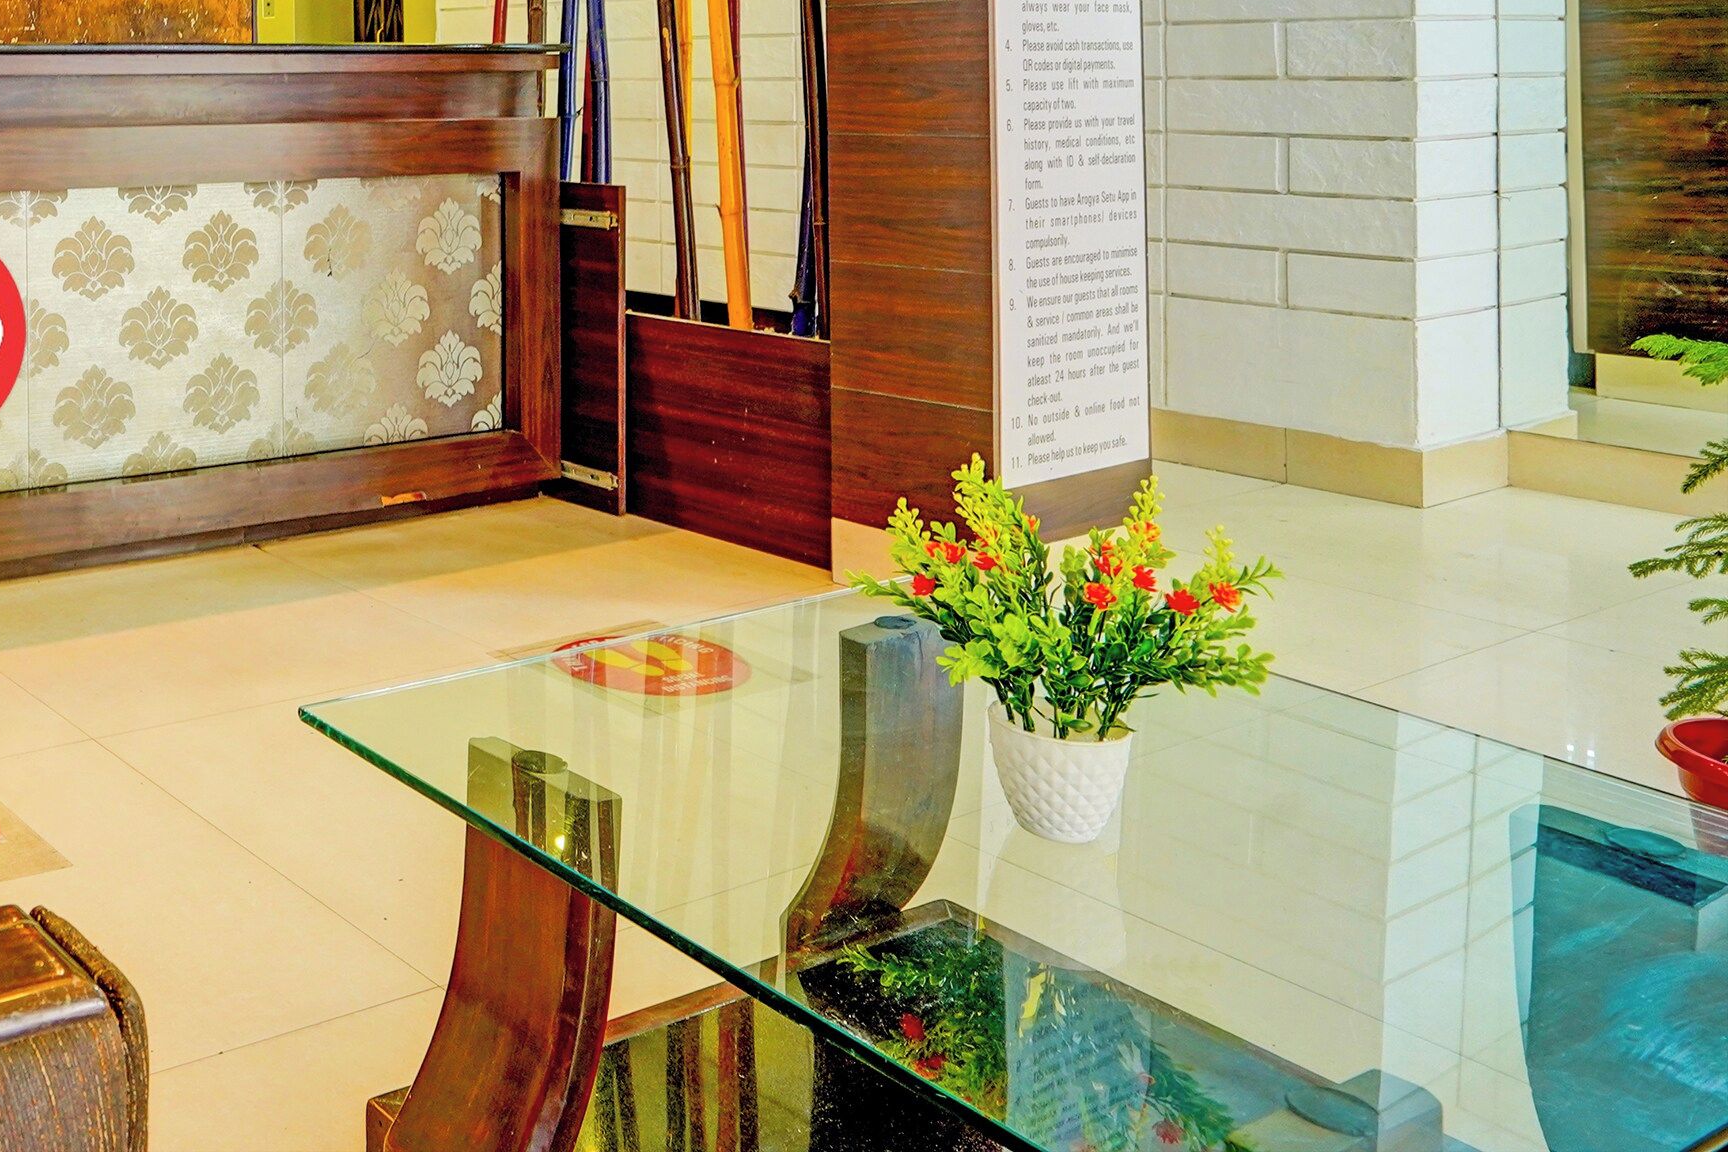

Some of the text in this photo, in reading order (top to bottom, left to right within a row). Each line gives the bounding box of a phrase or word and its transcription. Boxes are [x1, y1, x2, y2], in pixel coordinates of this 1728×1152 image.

[1022, 1, 1048, 14] always
[1052, 2, 1069, 12] wear
[1075, 2, 1090, 14] your
[1095, 1, 1109, 12] face
[1023, 39, 1044, 51] Please
[1046, 39, 1063, 52] avoid
[1065, 39, 1079, 51] cash
[1123, 41, 1133, 51] use
[1023, 58, 1115, 73] QR codes or digital payments.
[1023, 79, 1047, 91] Please
[1052, 81, 1064, 90] use
[1083, 77, 1098, 89] with
[1103, 77, 1134, 89] maximum
[1023, 98, 1052, 112] capacity
[1053, 98, 1060, 110] of
[1024, 114, 1135, 132] Please provide us with your travel
[1055, 136, 1081, 149] medical
[1024, 158, 1042, 172] along
[1047, 156, 1062, 168] with
[1078, 155, 1084, 167] &
[1088, 153, 1135, 165] self-declaration
[1025, 176, 1043, 190] form.
[1025, 198, 1049, 210] Guests
[1051, 197, 1058, 208] to
[1059, 195, 1075, 206] have
[1117, 190, 1129, 203] App
[1025, 209, 1137, 230] their devices
[1026, 245, 1137, 269] Guests are encouraged to minimise
[1026, 270, 1104, 289] the use of house keeping
[1027, 296, 1037, 308] We
[1039, 294, 1061, 306] ensure
[1063, 293, 1073, 303] our
[1074, 290, 1095, 305] guests
[1097, 287, 1110, 299] that
[1120, 285, 1138, 295] rooms
[1027, 302, 1138, 328] & service common areas shall be
[1027, 322, 1119, 348] sanitized And
[1028, 340, 1139, 368] keep the room unoccupied for
[1028, 358, 1139, 387] atleast 24 hours after the guest
[1028, 396, 1140, 426] No outside & online food not
[1028, 431, 1056, 446] allowed.
[1028, 441, 1111, 466] Please help us to keep you
